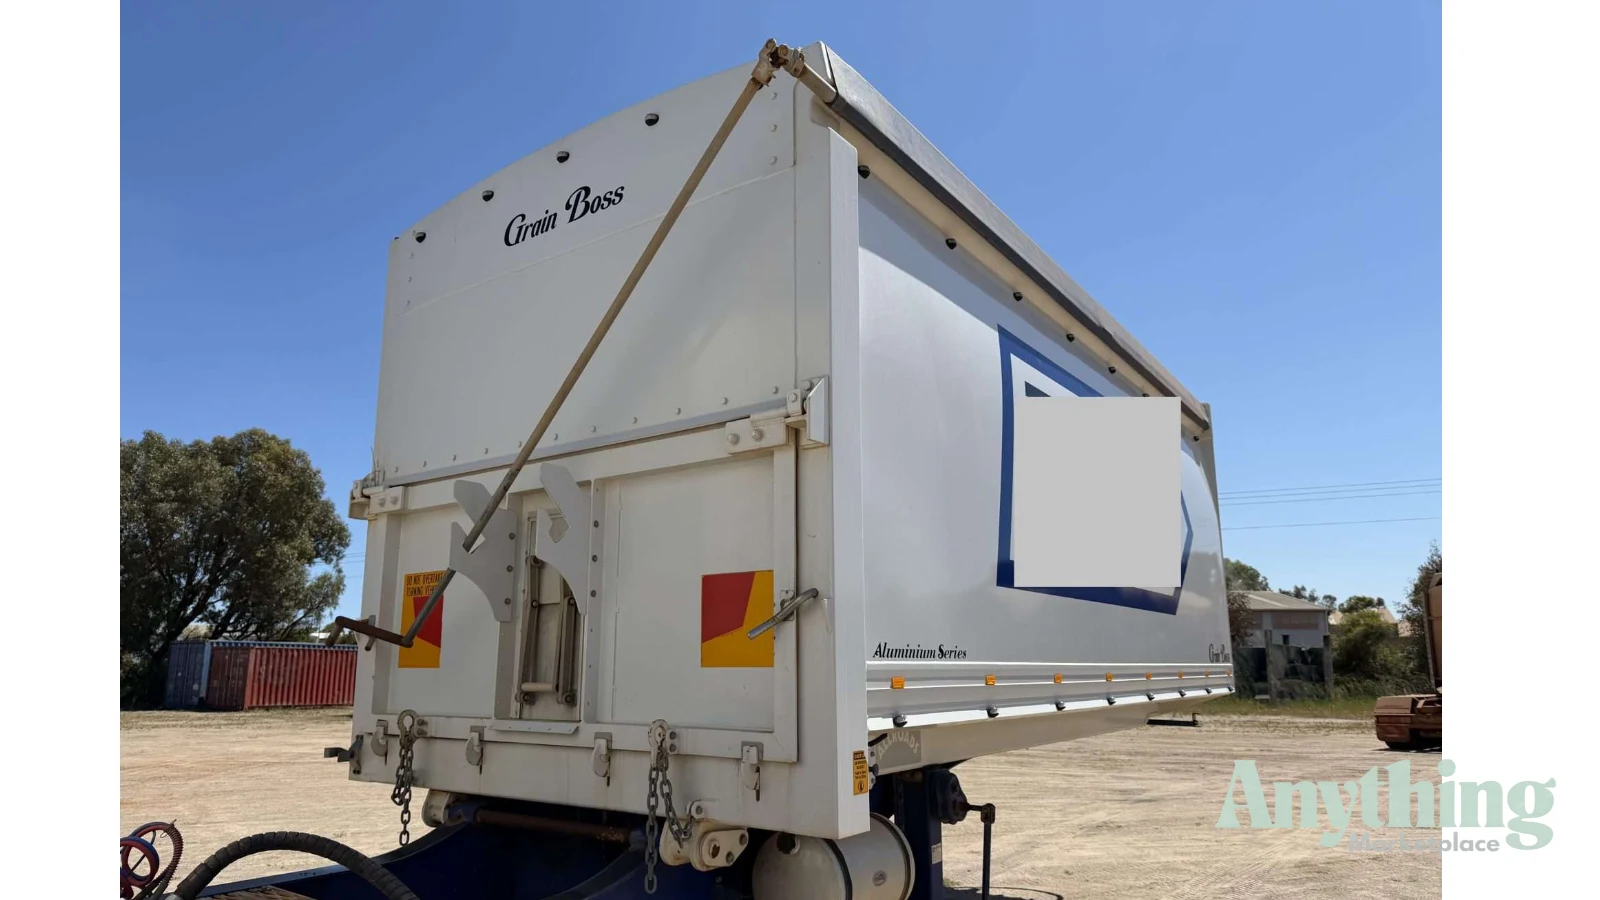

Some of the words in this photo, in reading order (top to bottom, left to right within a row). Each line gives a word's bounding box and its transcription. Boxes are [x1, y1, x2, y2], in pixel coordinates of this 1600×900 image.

[504, 213, 558, 247] Grain
[564, 185, 625, 224] Boss
[872, 641, 936, 659] Aluminium
[937, 643, 968, 660] Series
